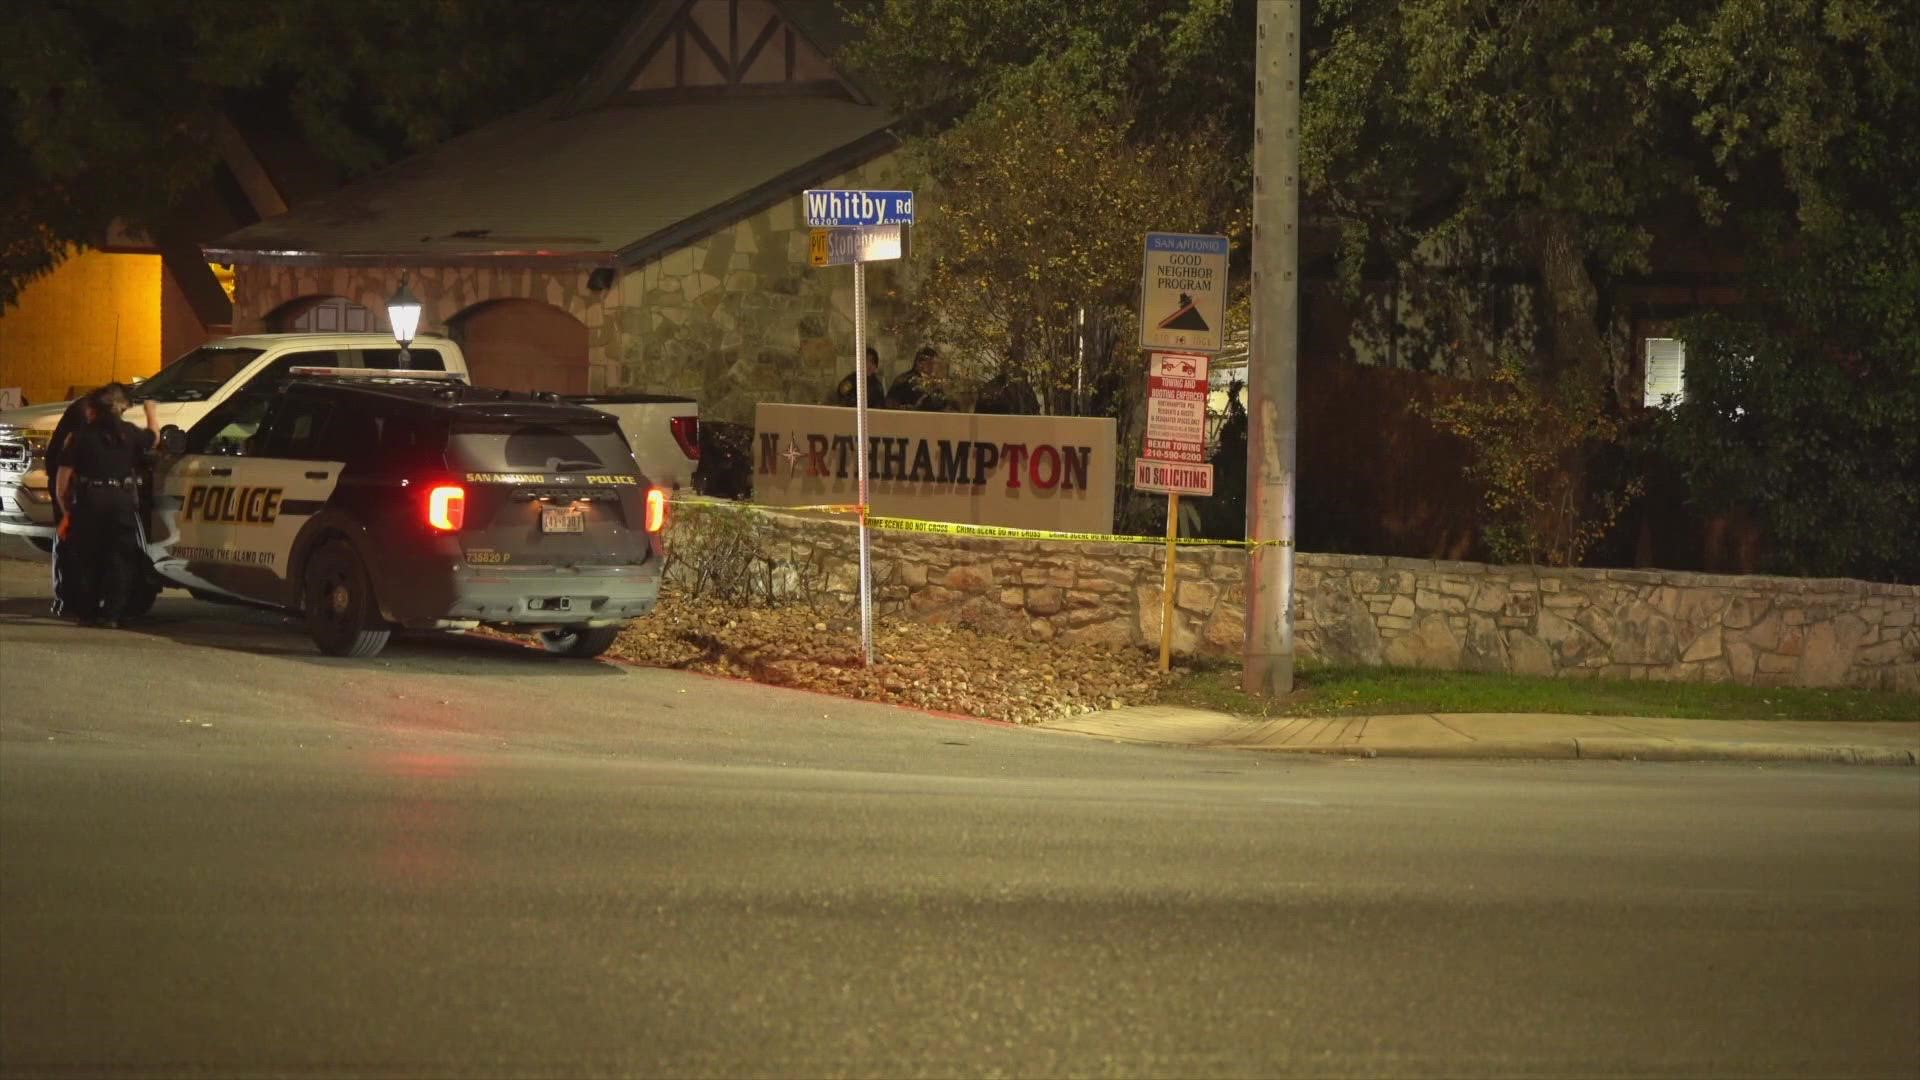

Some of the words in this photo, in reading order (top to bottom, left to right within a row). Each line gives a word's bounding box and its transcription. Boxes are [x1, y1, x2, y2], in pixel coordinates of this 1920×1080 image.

[809, 192, 886, 225] Whitby
[896, 199, 911, 214] Rd
[1155, 239, 1174, 248] SAN
[1176, 241, 1219, 250] ANTONIO
[1170, 254, 1202, 266] GOOD
[1157, 266, 1212, 278] NEIGHBOR
[1158, 278, 1211, 291] PROGRAM
[1162, 378, 1183, 388] TOWING
[1184, 380, 1196, 389] AND
[1148, 440, 1171, 450] BEXAR
[1173, 442, 1201, 453] TOWING
[466, 473, 491, 483] SAN
[492, 474, 545, 484] ANTONIO
[586, 475, 637, 485] POLICE
[1139, 466, 1151, 484] NO
[1153, 467, 1207, 489] SOLICITING
[184, 485, 284, 524] POLICE
[864, 518, 883, 527] CRIME
[884, 520, 904, 529] SCENE
[905, 521, 914, 530] DO
[915, 522, 928, 531] NOT
[929, 523, 949, 533] CROSS
[233, 550, 257, 562] ALAMO
[258, 551, 275, 564] CITY
